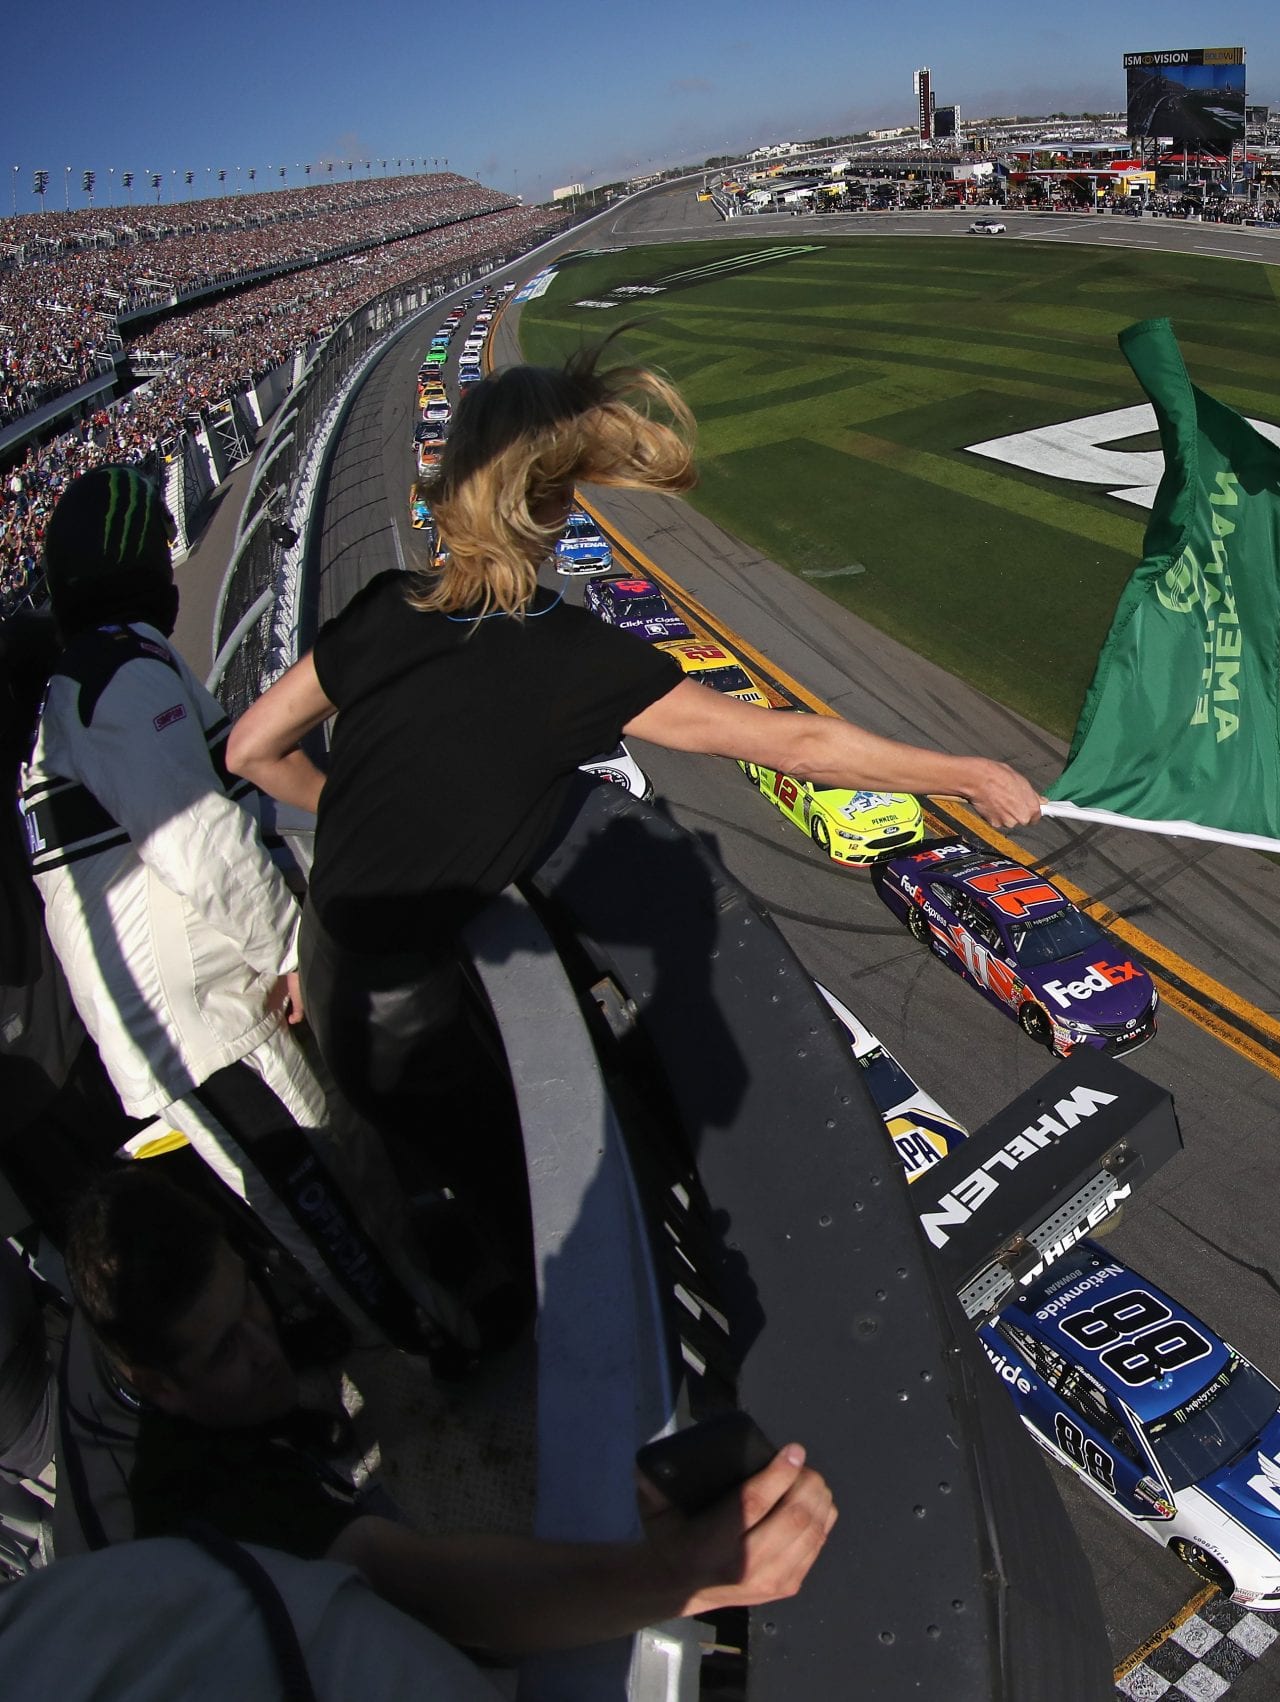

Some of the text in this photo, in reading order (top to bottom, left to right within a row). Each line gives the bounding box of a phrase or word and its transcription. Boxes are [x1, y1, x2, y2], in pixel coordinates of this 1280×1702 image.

[1124, 52, 1189, 66] ISM VISION
[560, 542, 609, 552] FASTENAL
[619, 619, 643, 629] Click
[774, 770, 798, 811] 12
[838, 791, 907, 820] PEAK
[871, 814, 899, 825] PENNZOIL
[912, 843, 971, 863] FedEx
[901, 874, 926, 908] FedEx
[922, 900, 947, 927] Express
[962, 866, 1065, 919] 11
[1042, 960, 1145, 1009] FedEx
[1115, 1023, 1148, 1042] CAMRY
[919, 1085, 1119, 1250] WHELEN
[1019, 1183, 1133, 1286] WHELEN
[1035, 1263, 1125, 1320] Nationwide
[1043, 1268, 1083, 1298] BOWMAN
[1058, 1289, 1213, 1388] 88
[1184, 1382, 1222, 1415] MONSTER
[1054, 1412, 1117, 1496] 88
